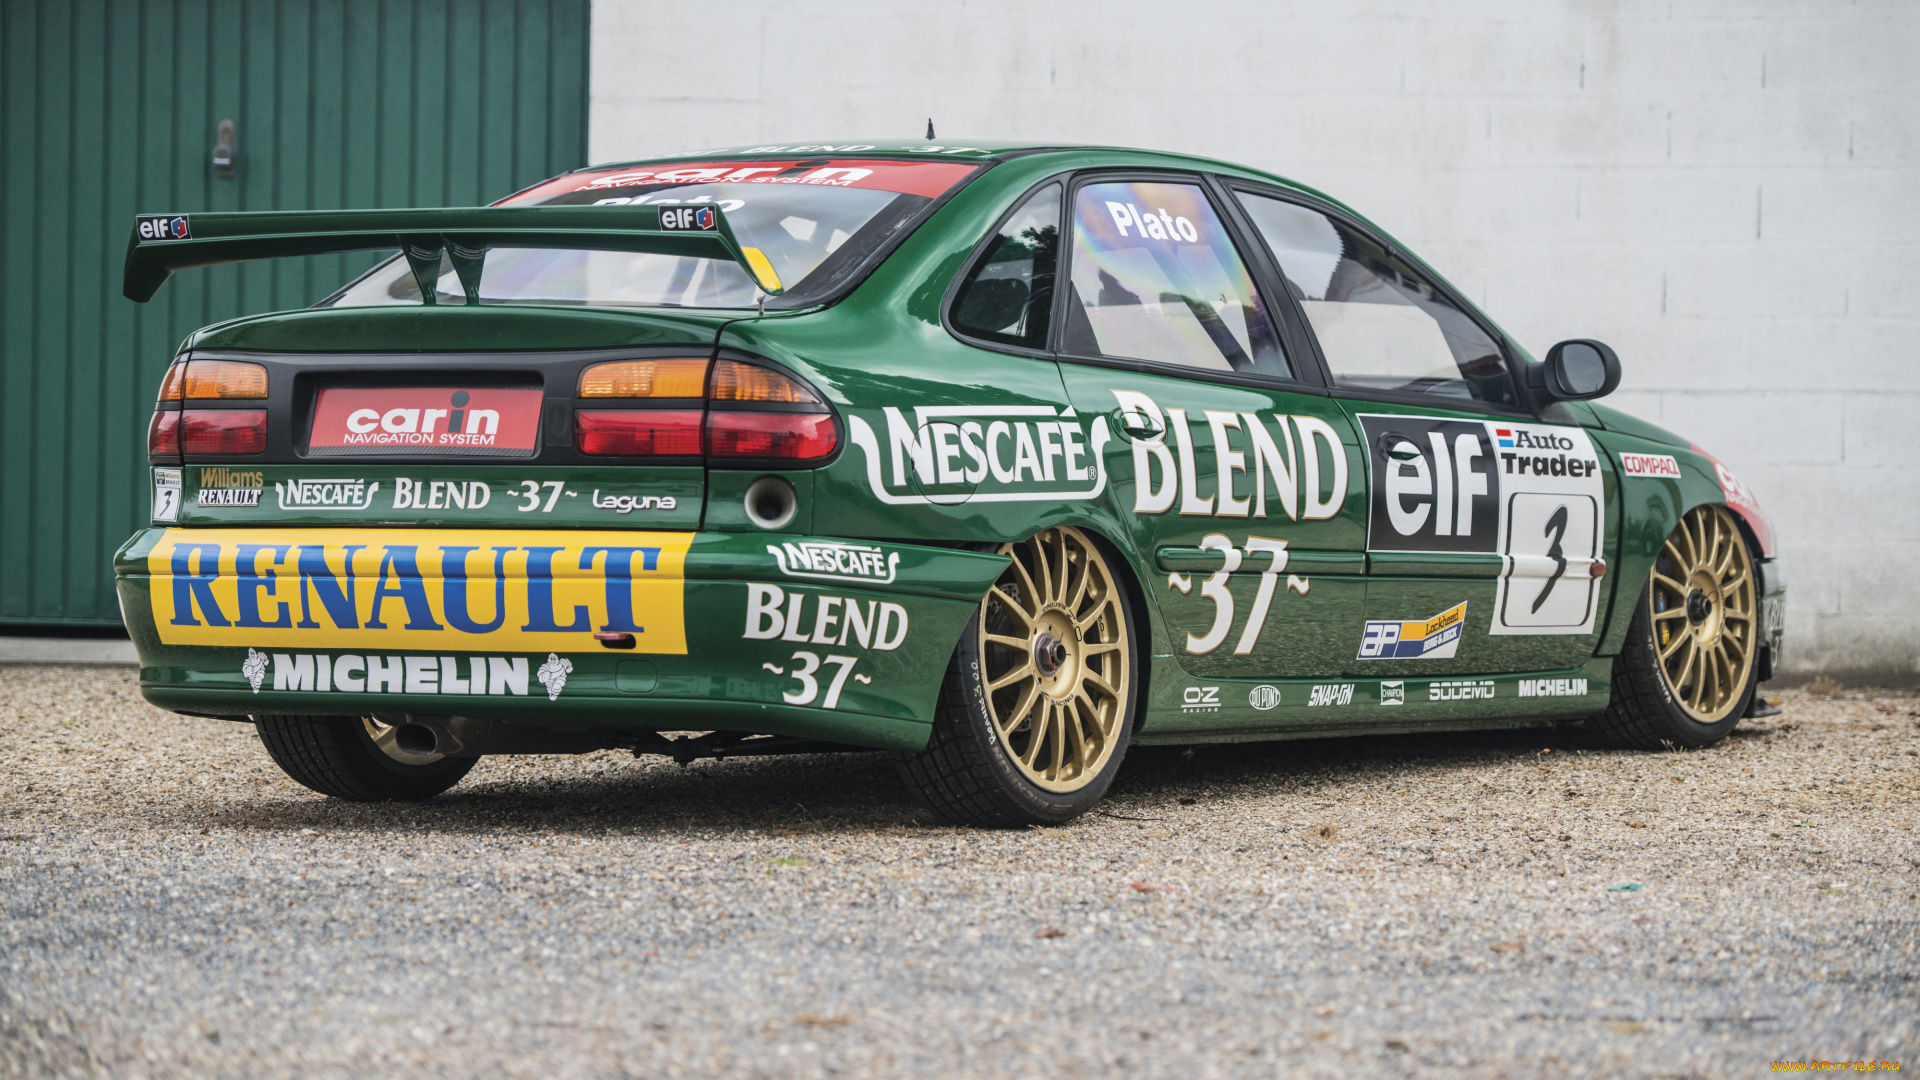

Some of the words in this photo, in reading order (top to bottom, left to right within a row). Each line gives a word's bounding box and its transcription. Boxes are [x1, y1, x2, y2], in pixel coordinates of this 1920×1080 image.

[740, 145, 875, 154] BLEND
[590, 160, 874, 185] carin
[752, 177, 854, 186] SYSTEM
[140, 219, 168, 238] elf
[662, 208, 693, 229] elf
[1105, 201, 1198, 243] Plato
[347, 390, 500, 434] carin
[343, 433, 434, 444] NAVIGATION
[439, 433, 495, 445] SYSTEM
[1515, 430, 1574, 451] Auto
[1110, 389, 1349, 521] BLEND
[1500, 452, 1597, 478] Trader
[1624, 456, 1680, 475] COMPAQ
[201, 468, 264, 488] Williams
[1385, 431, 1488, 537] elf
[159, 490, 173, 517] 3
[198, 489, 262, 505] RENAULT
[286, 478, 365, 505] NESCAFÉ
[392, 477, 490, 510] BLEND
[781, 542, 888, 578] NESCAFÉ
[1531, 503, 1568, 615] 3
[169, 541, 662, 634] RENAULT
[742, 582, 909, 651] BLEND
[1426, 608, 1459, 636] Lockheed
[272, 653, 529, 695] MICHELIN
[1429, 681, 1495, 700] SODEMO
[1518, 679, 1588, 697] MICHELIN
